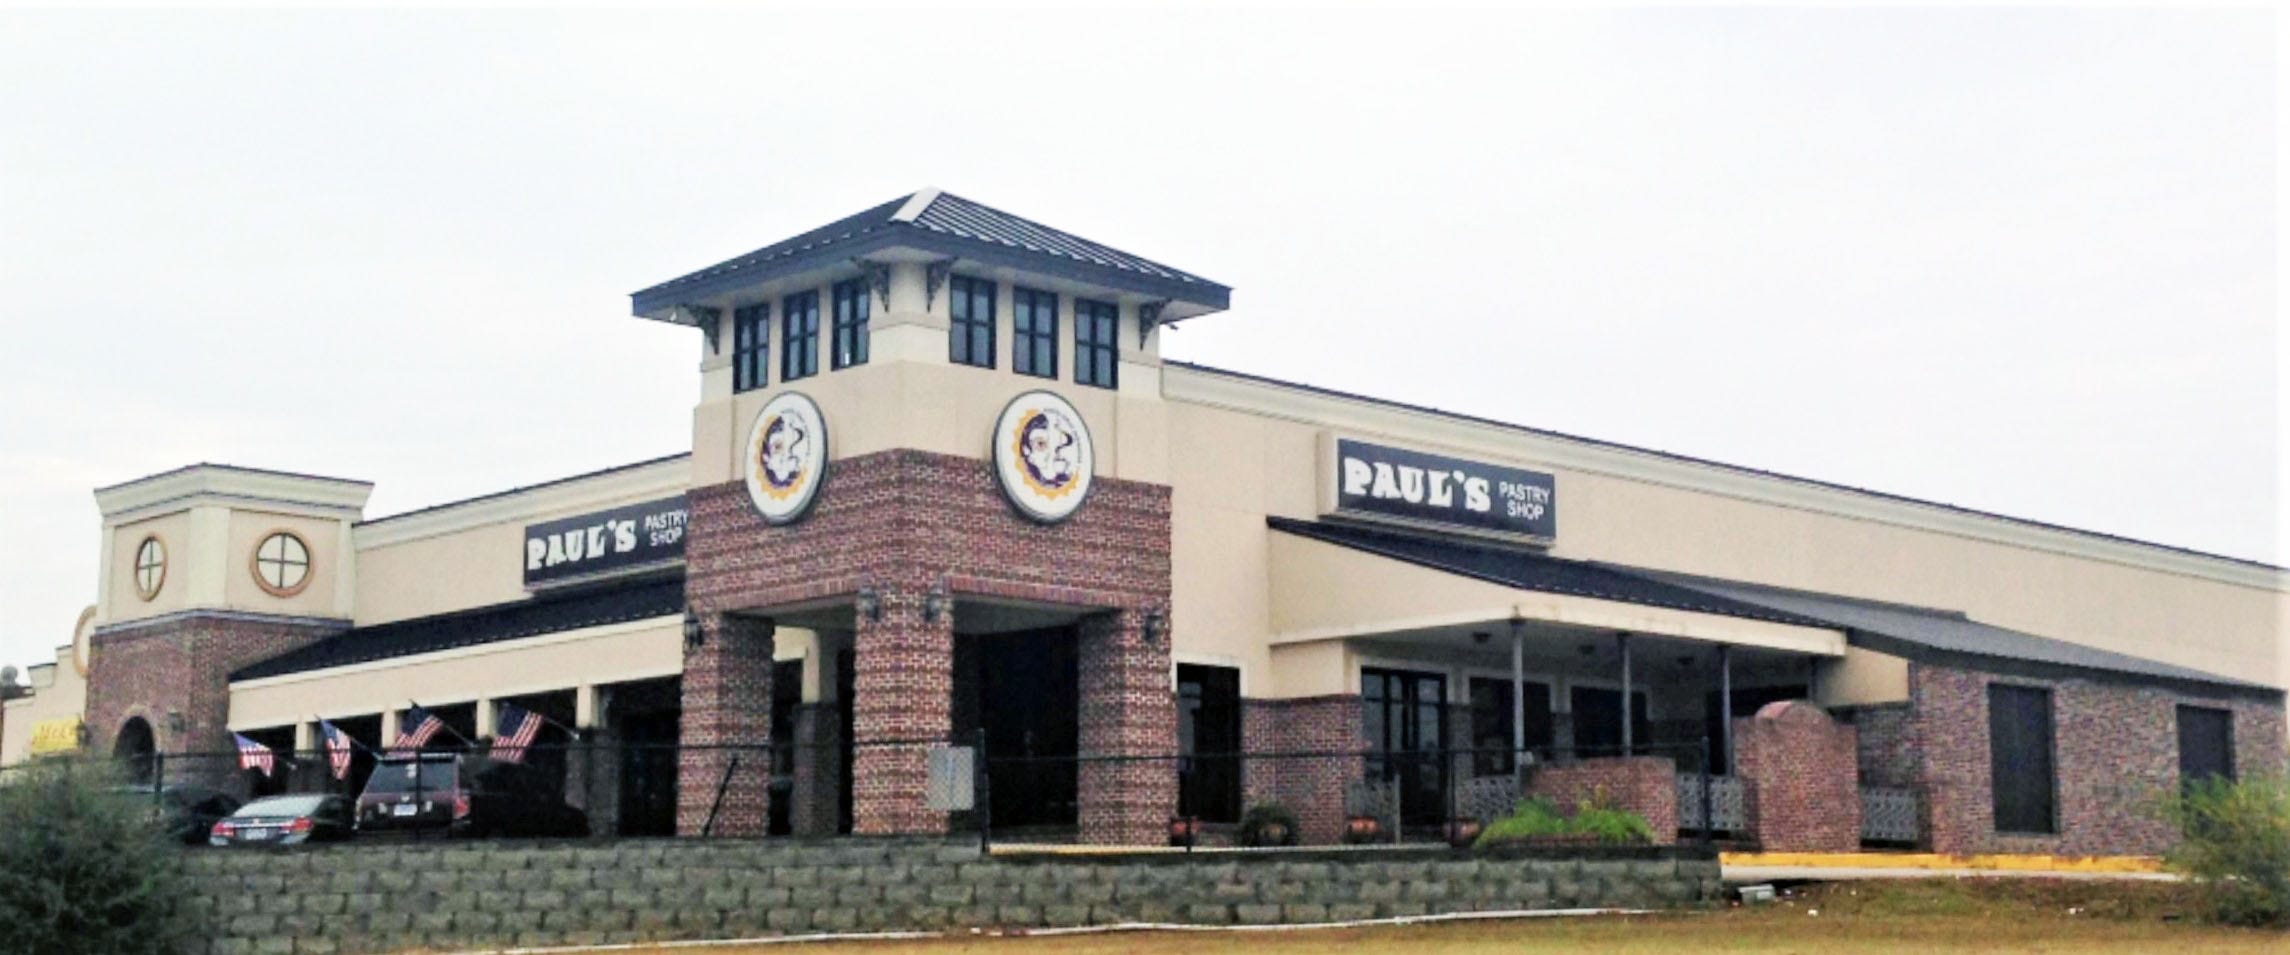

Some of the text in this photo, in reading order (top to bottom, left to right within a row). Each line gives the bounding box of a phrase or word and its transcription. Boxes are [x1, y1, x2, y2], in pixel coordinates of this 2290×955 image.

[1343, 456, 1491, 512] PAUL'S
[1499, 481, 1551, 504] PASTRY
[644, 509, 688, 531] PASTRY
[1507, 500, 1545, 521] SHOP
[527, 518, 638, 571] PAUL'S
[650, 527, 683, 547] SHOP
